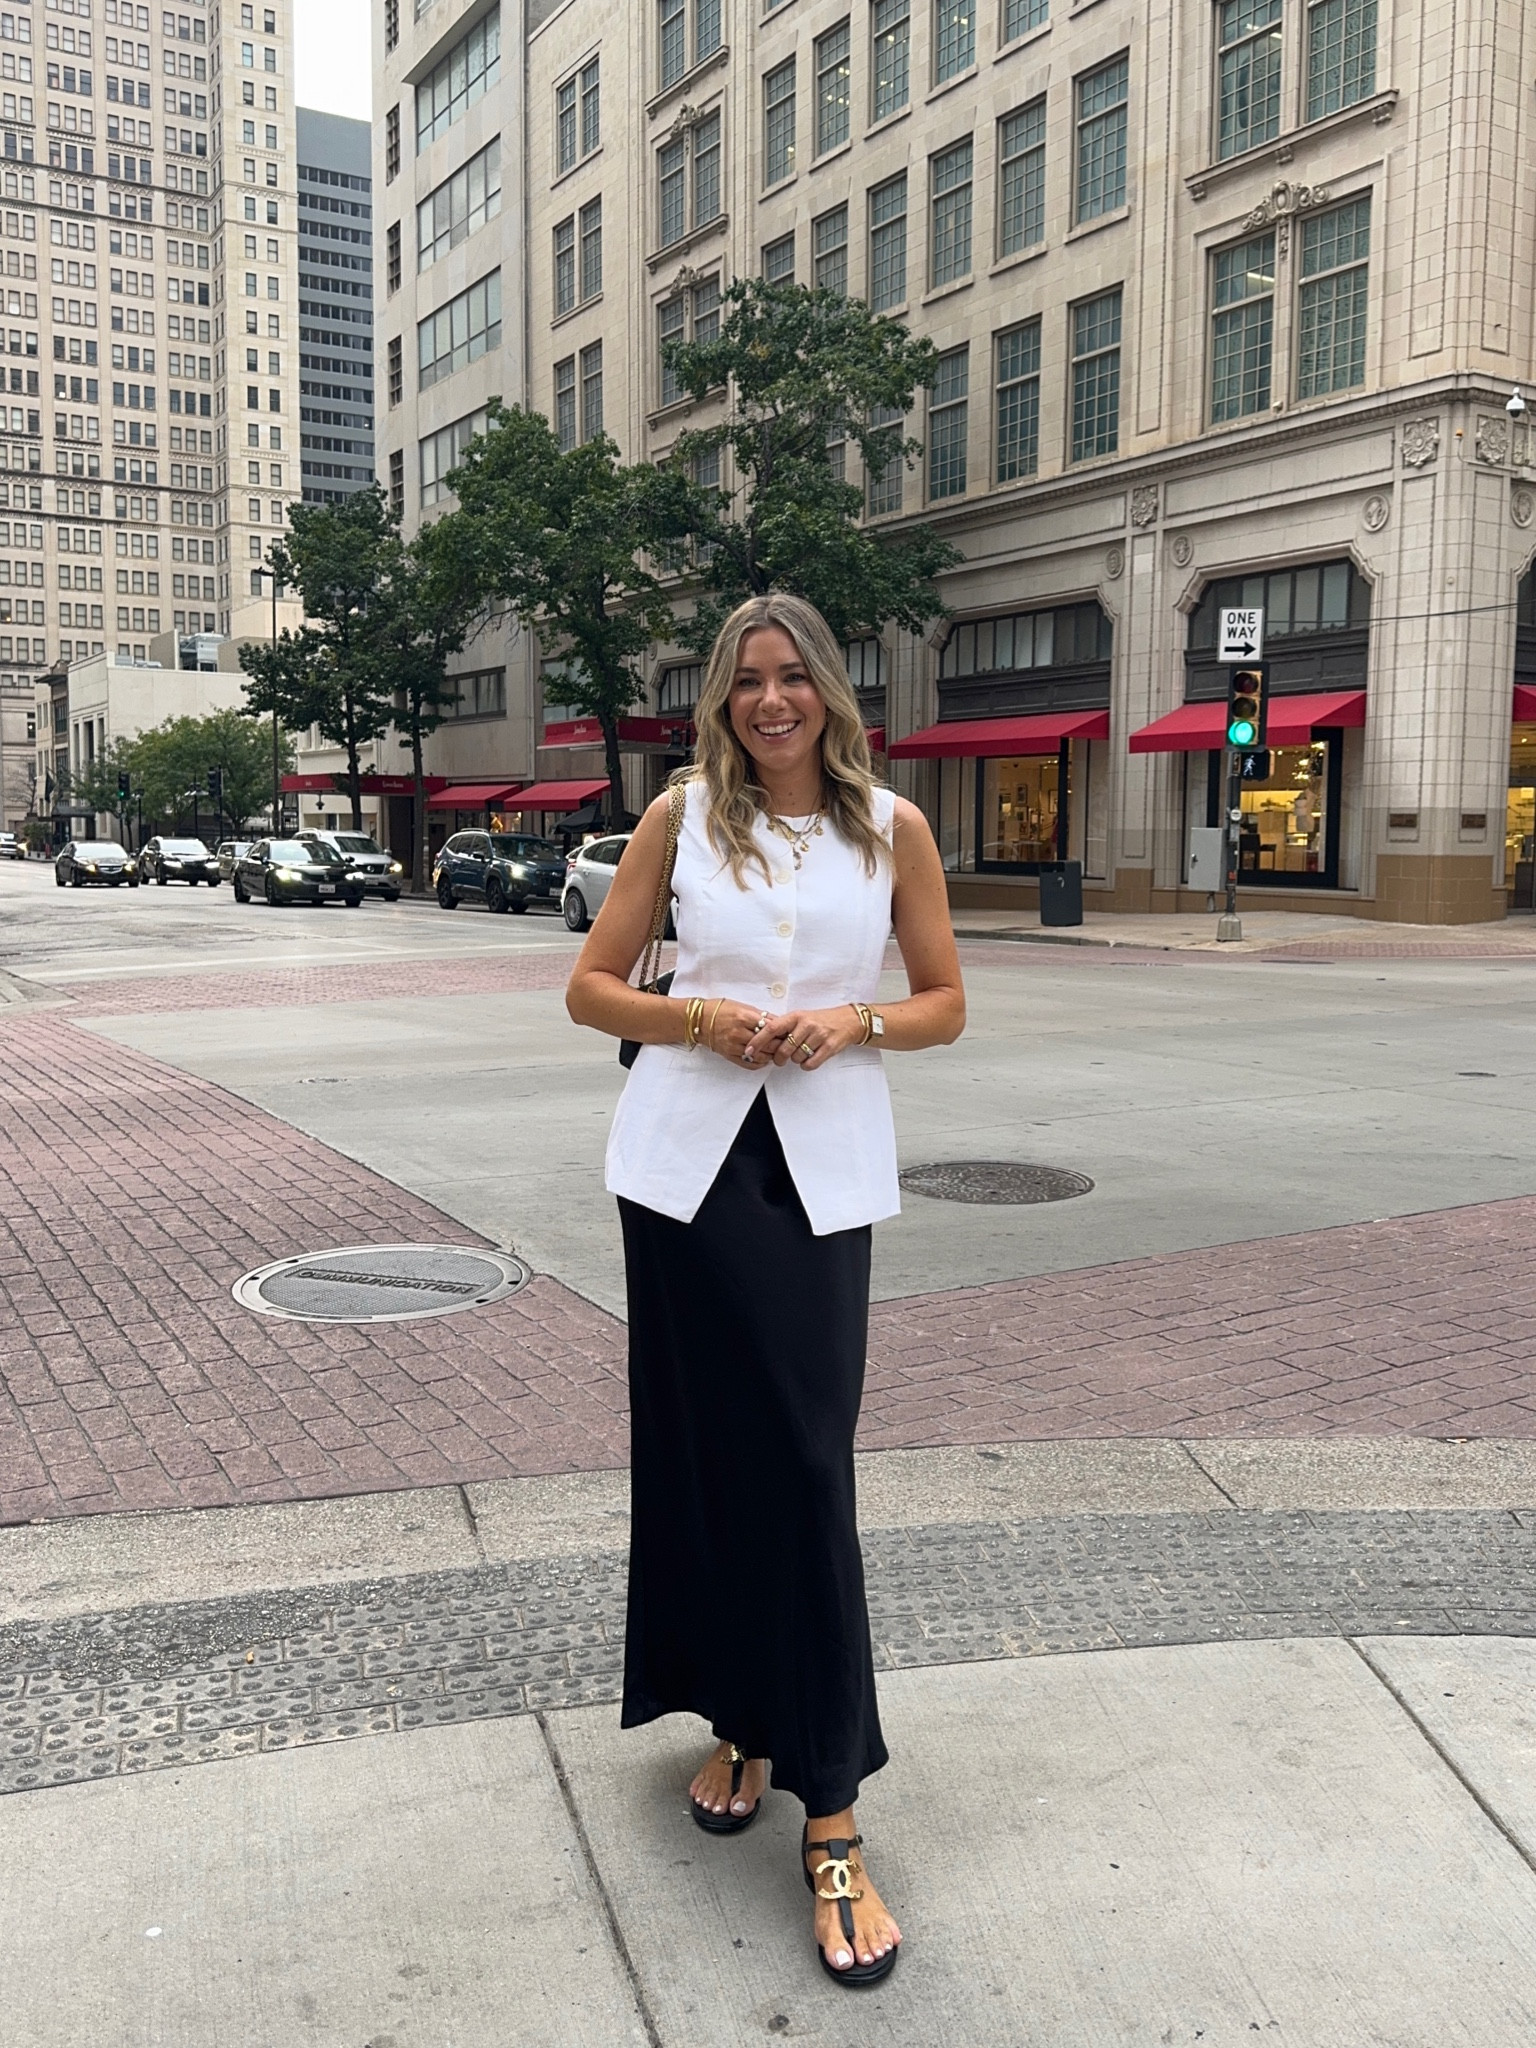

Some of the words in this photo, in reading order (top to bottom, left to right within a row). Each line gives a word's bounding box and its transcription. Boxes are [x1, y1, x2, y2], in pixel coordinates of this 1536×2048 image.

[1227, 612, 1256, 624] ONE
[1227, 626, 1257, 639] WAY
[299, 1271, 473, 1295] COMMUNICATION
